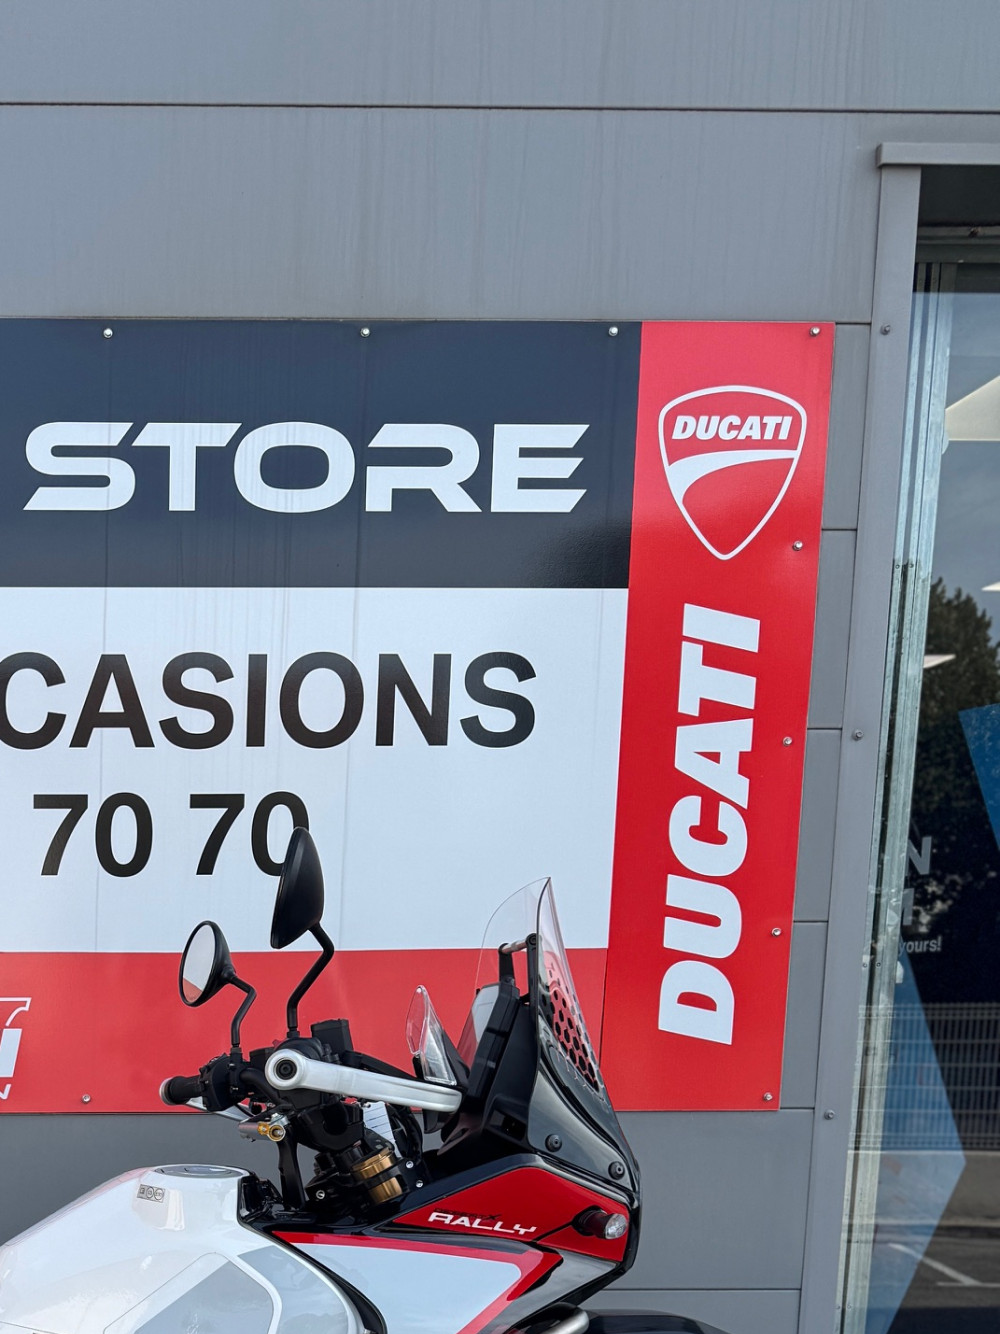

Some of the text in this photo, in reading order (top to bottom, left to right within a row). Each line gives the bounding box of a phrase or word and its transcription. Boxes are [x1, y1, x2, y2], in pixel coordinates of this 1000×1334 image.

[23, 421, 591, 514] STORE
[671, 415, 793, 441] DUCATI
[32, 791, 154, 878] 70
[189, 791, 310, 877] 70
[658, 603, 761, 1046] DUCATI
[427, 1211, 538, 1235] RALLY
